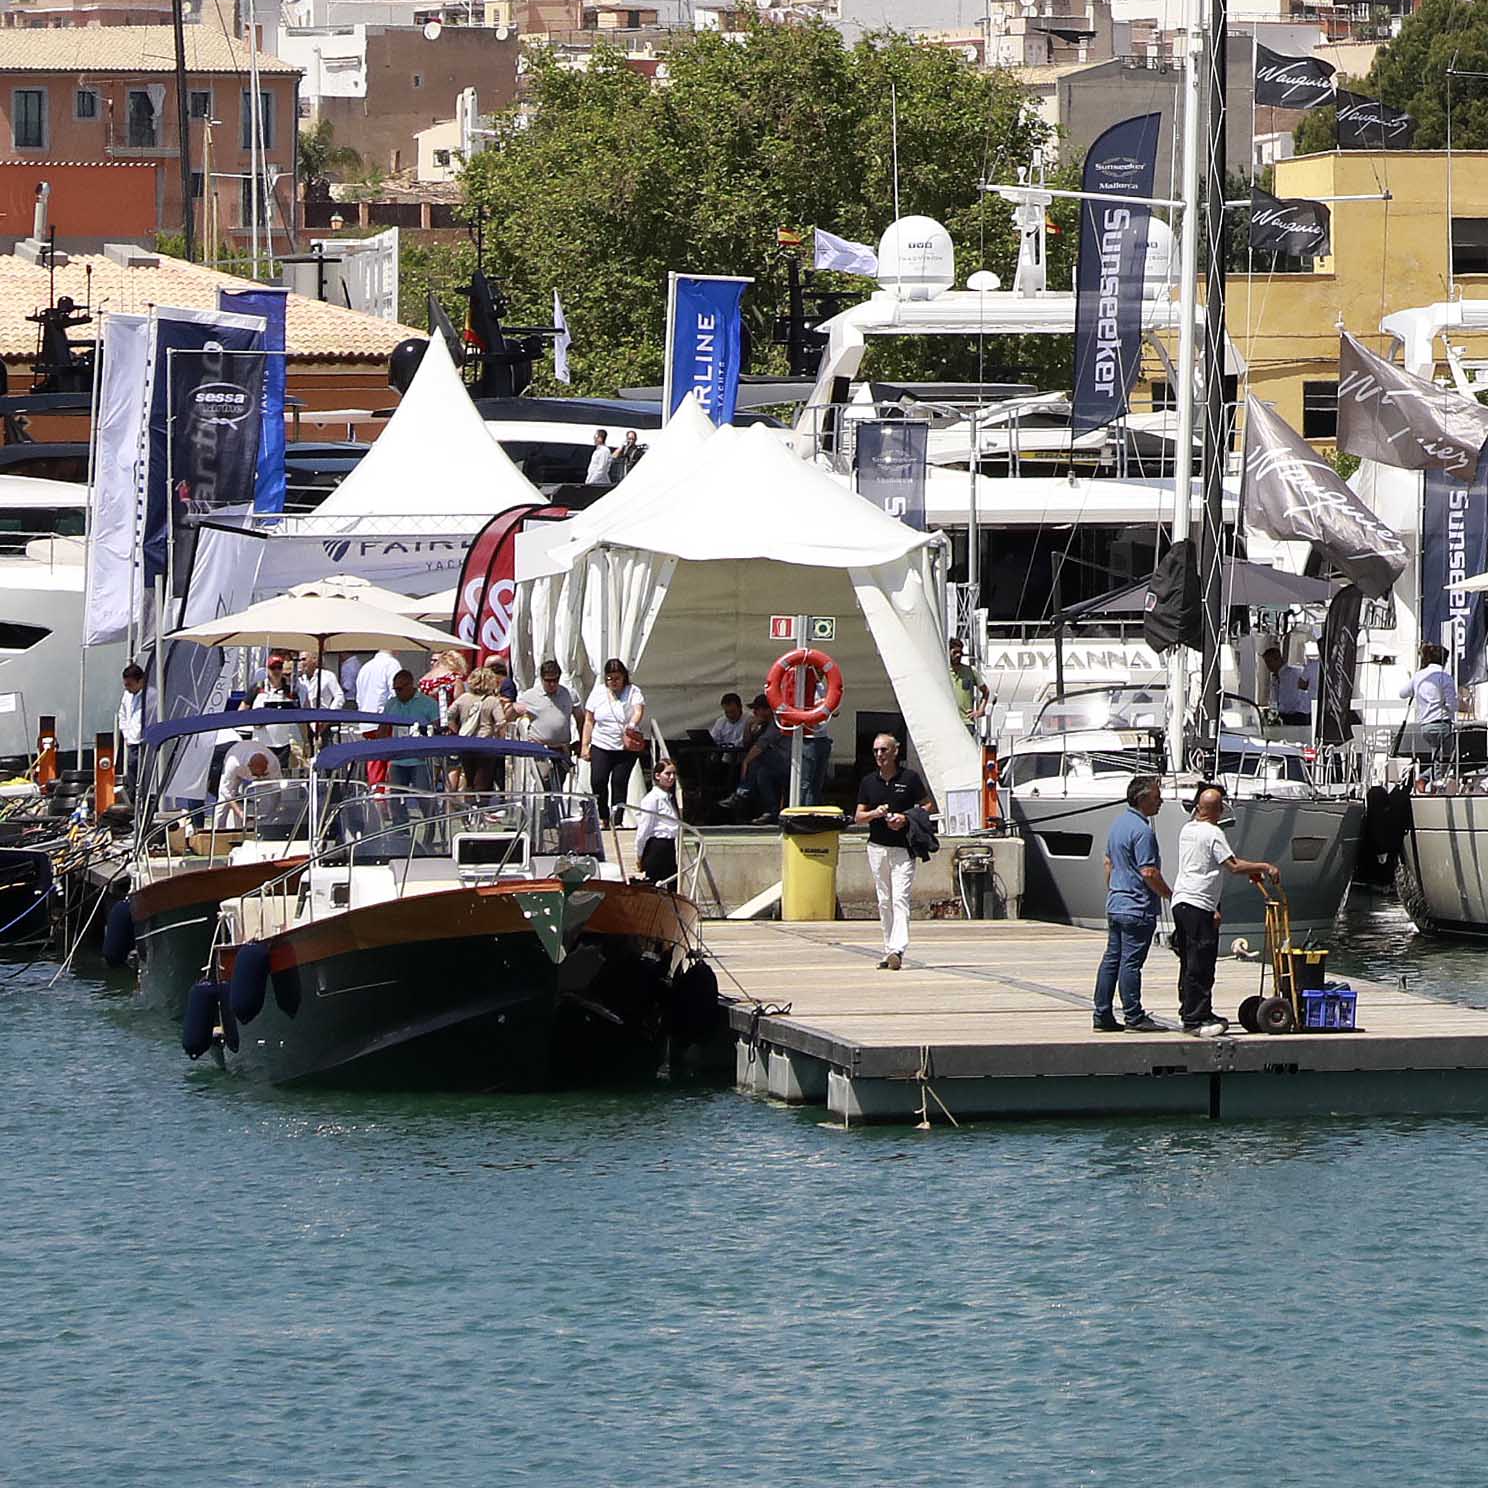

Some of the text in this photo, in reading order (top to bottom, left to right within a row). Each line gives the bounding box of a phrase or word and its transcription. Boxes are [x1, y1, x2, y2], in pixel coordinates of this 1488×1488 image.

[1095, 162, 1146, 172] Sunseeker
[1095, 208, 1131, 398] Sunseeker
[195, 393, 247, 404] sessa
[1063, 651, 1149, 671] ANNA
